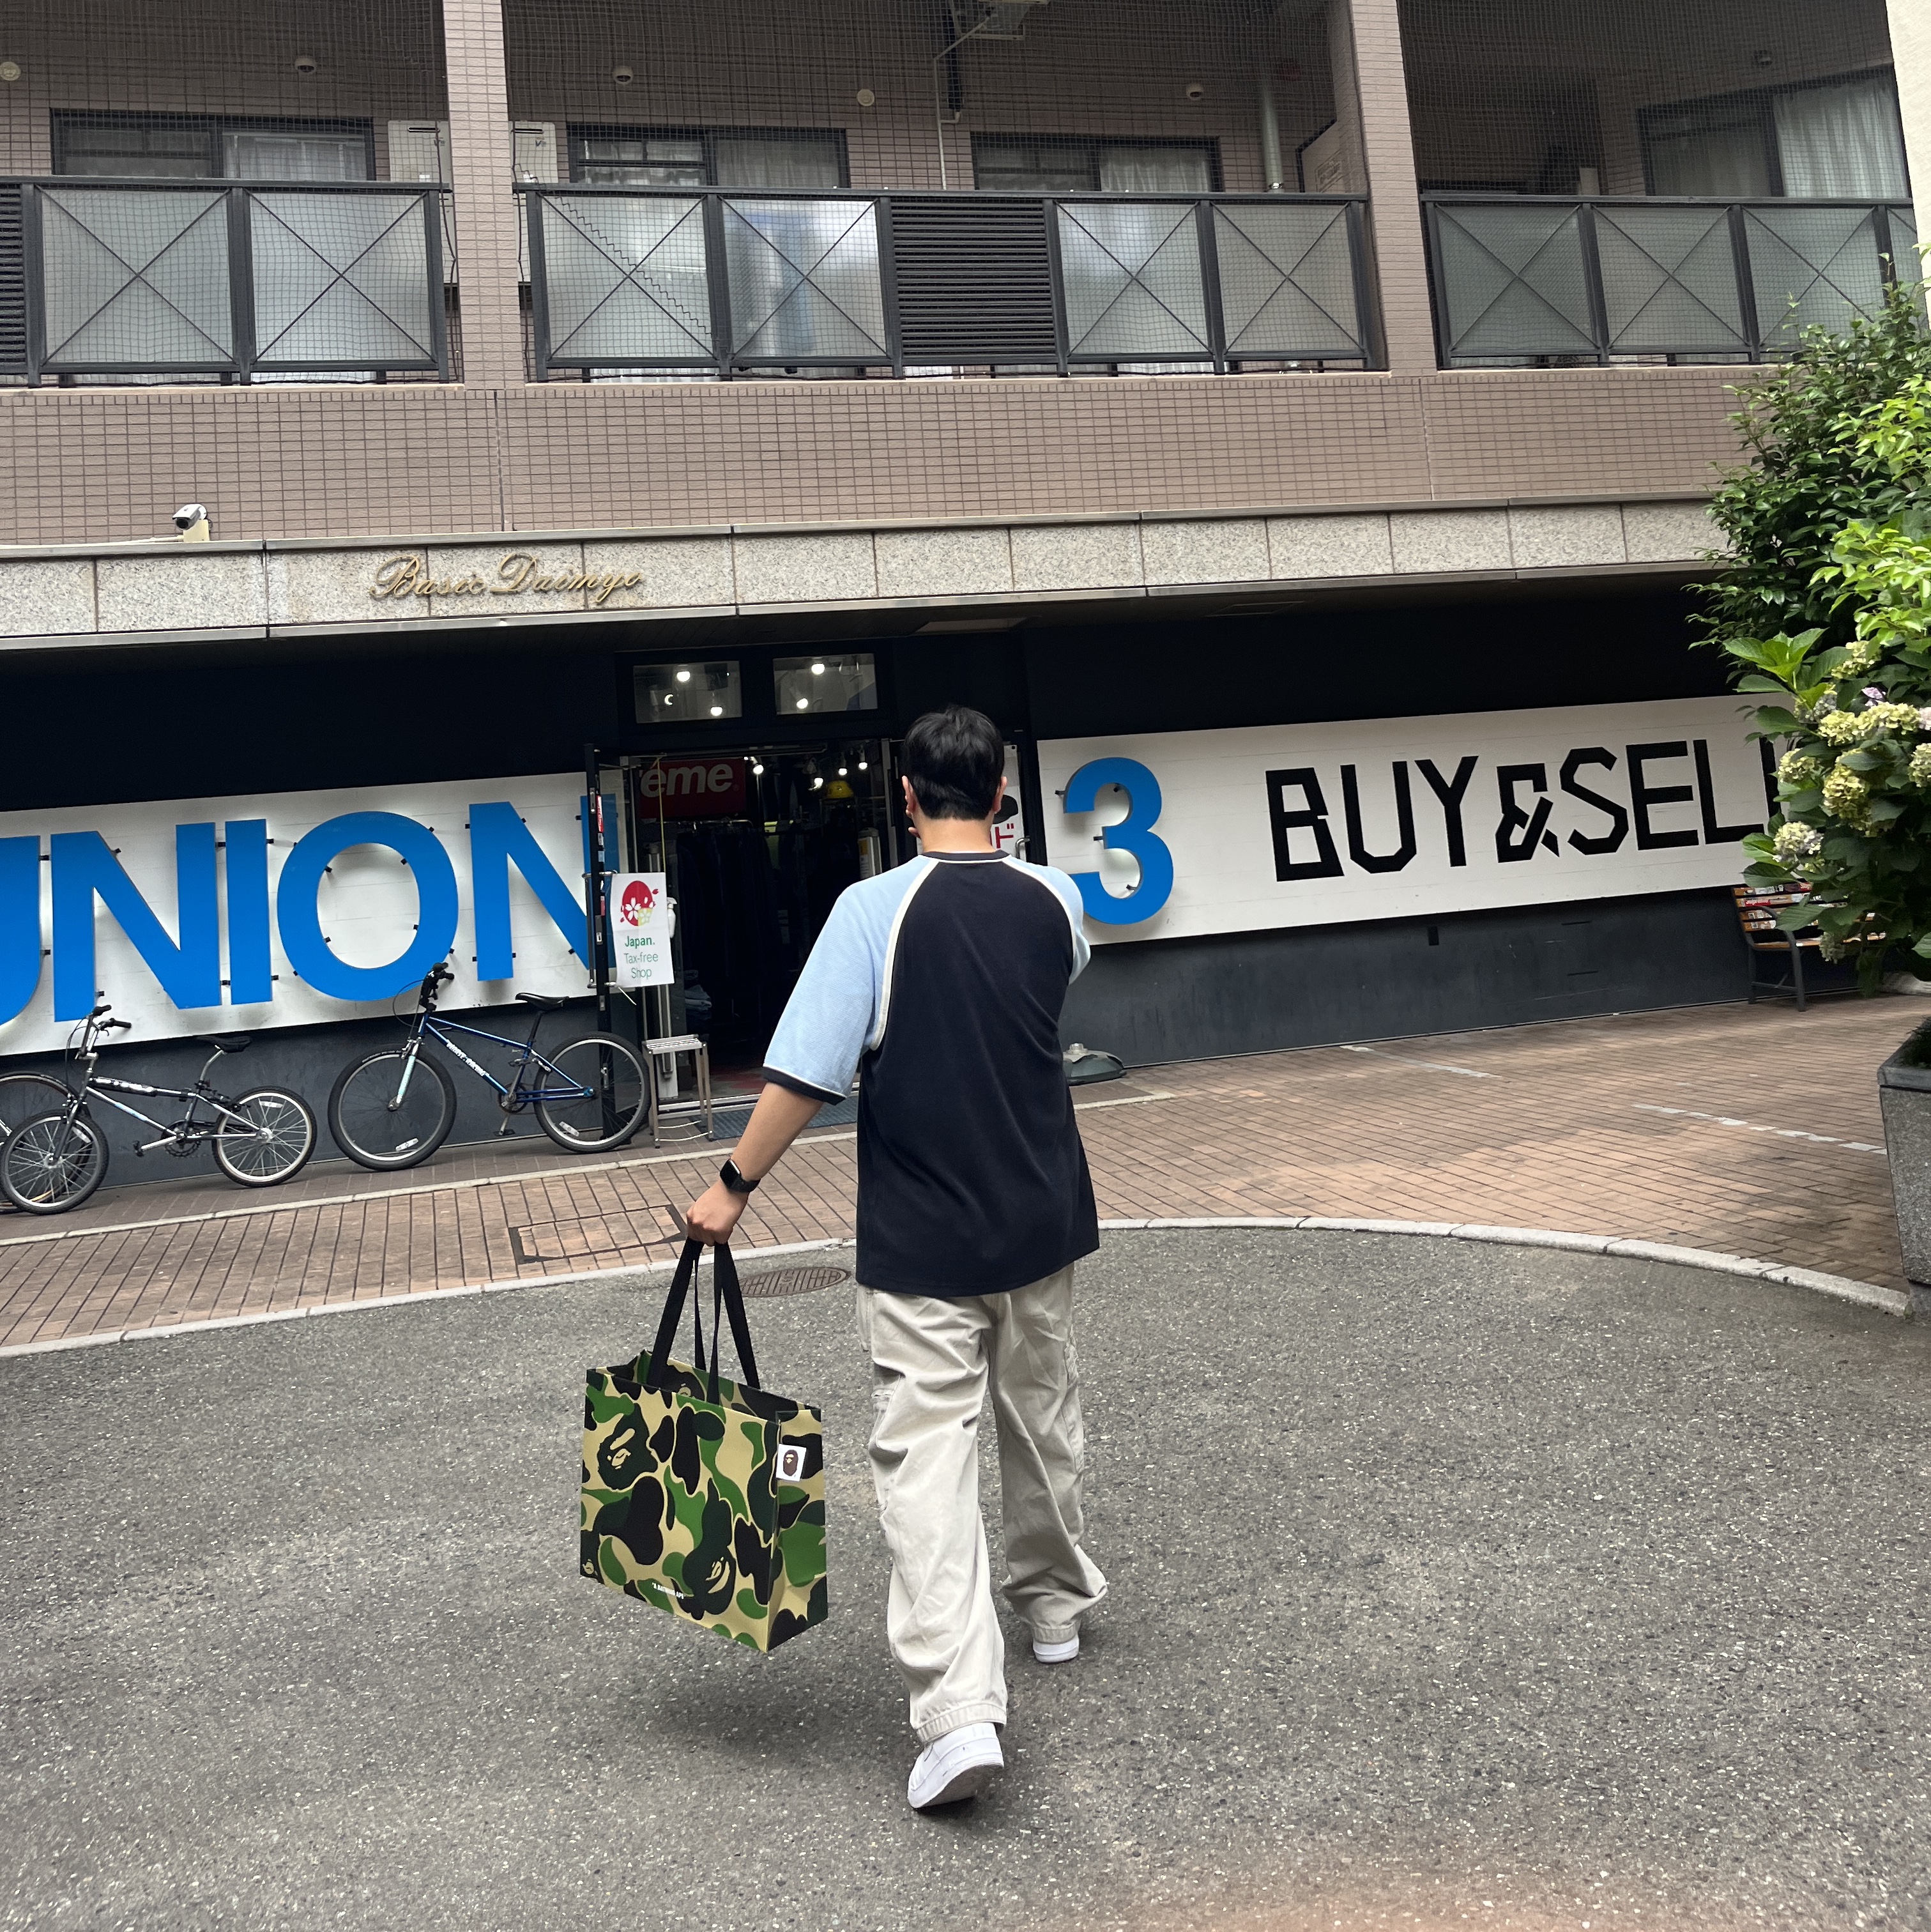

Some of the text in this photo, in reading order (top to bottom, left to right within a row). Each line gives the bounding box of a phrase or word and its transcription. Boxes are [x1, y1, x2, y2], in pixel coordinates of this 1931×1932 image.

[370, 552, 641, 604] Basic Daimyo
[639, 763, 733, 798] eme
[989, 823, 1014, 849] ド
[1063, 756, 1174, 925] 3
[623, 951, 659, 964] Tax-free
[631, 967, 652, 980] Shop
